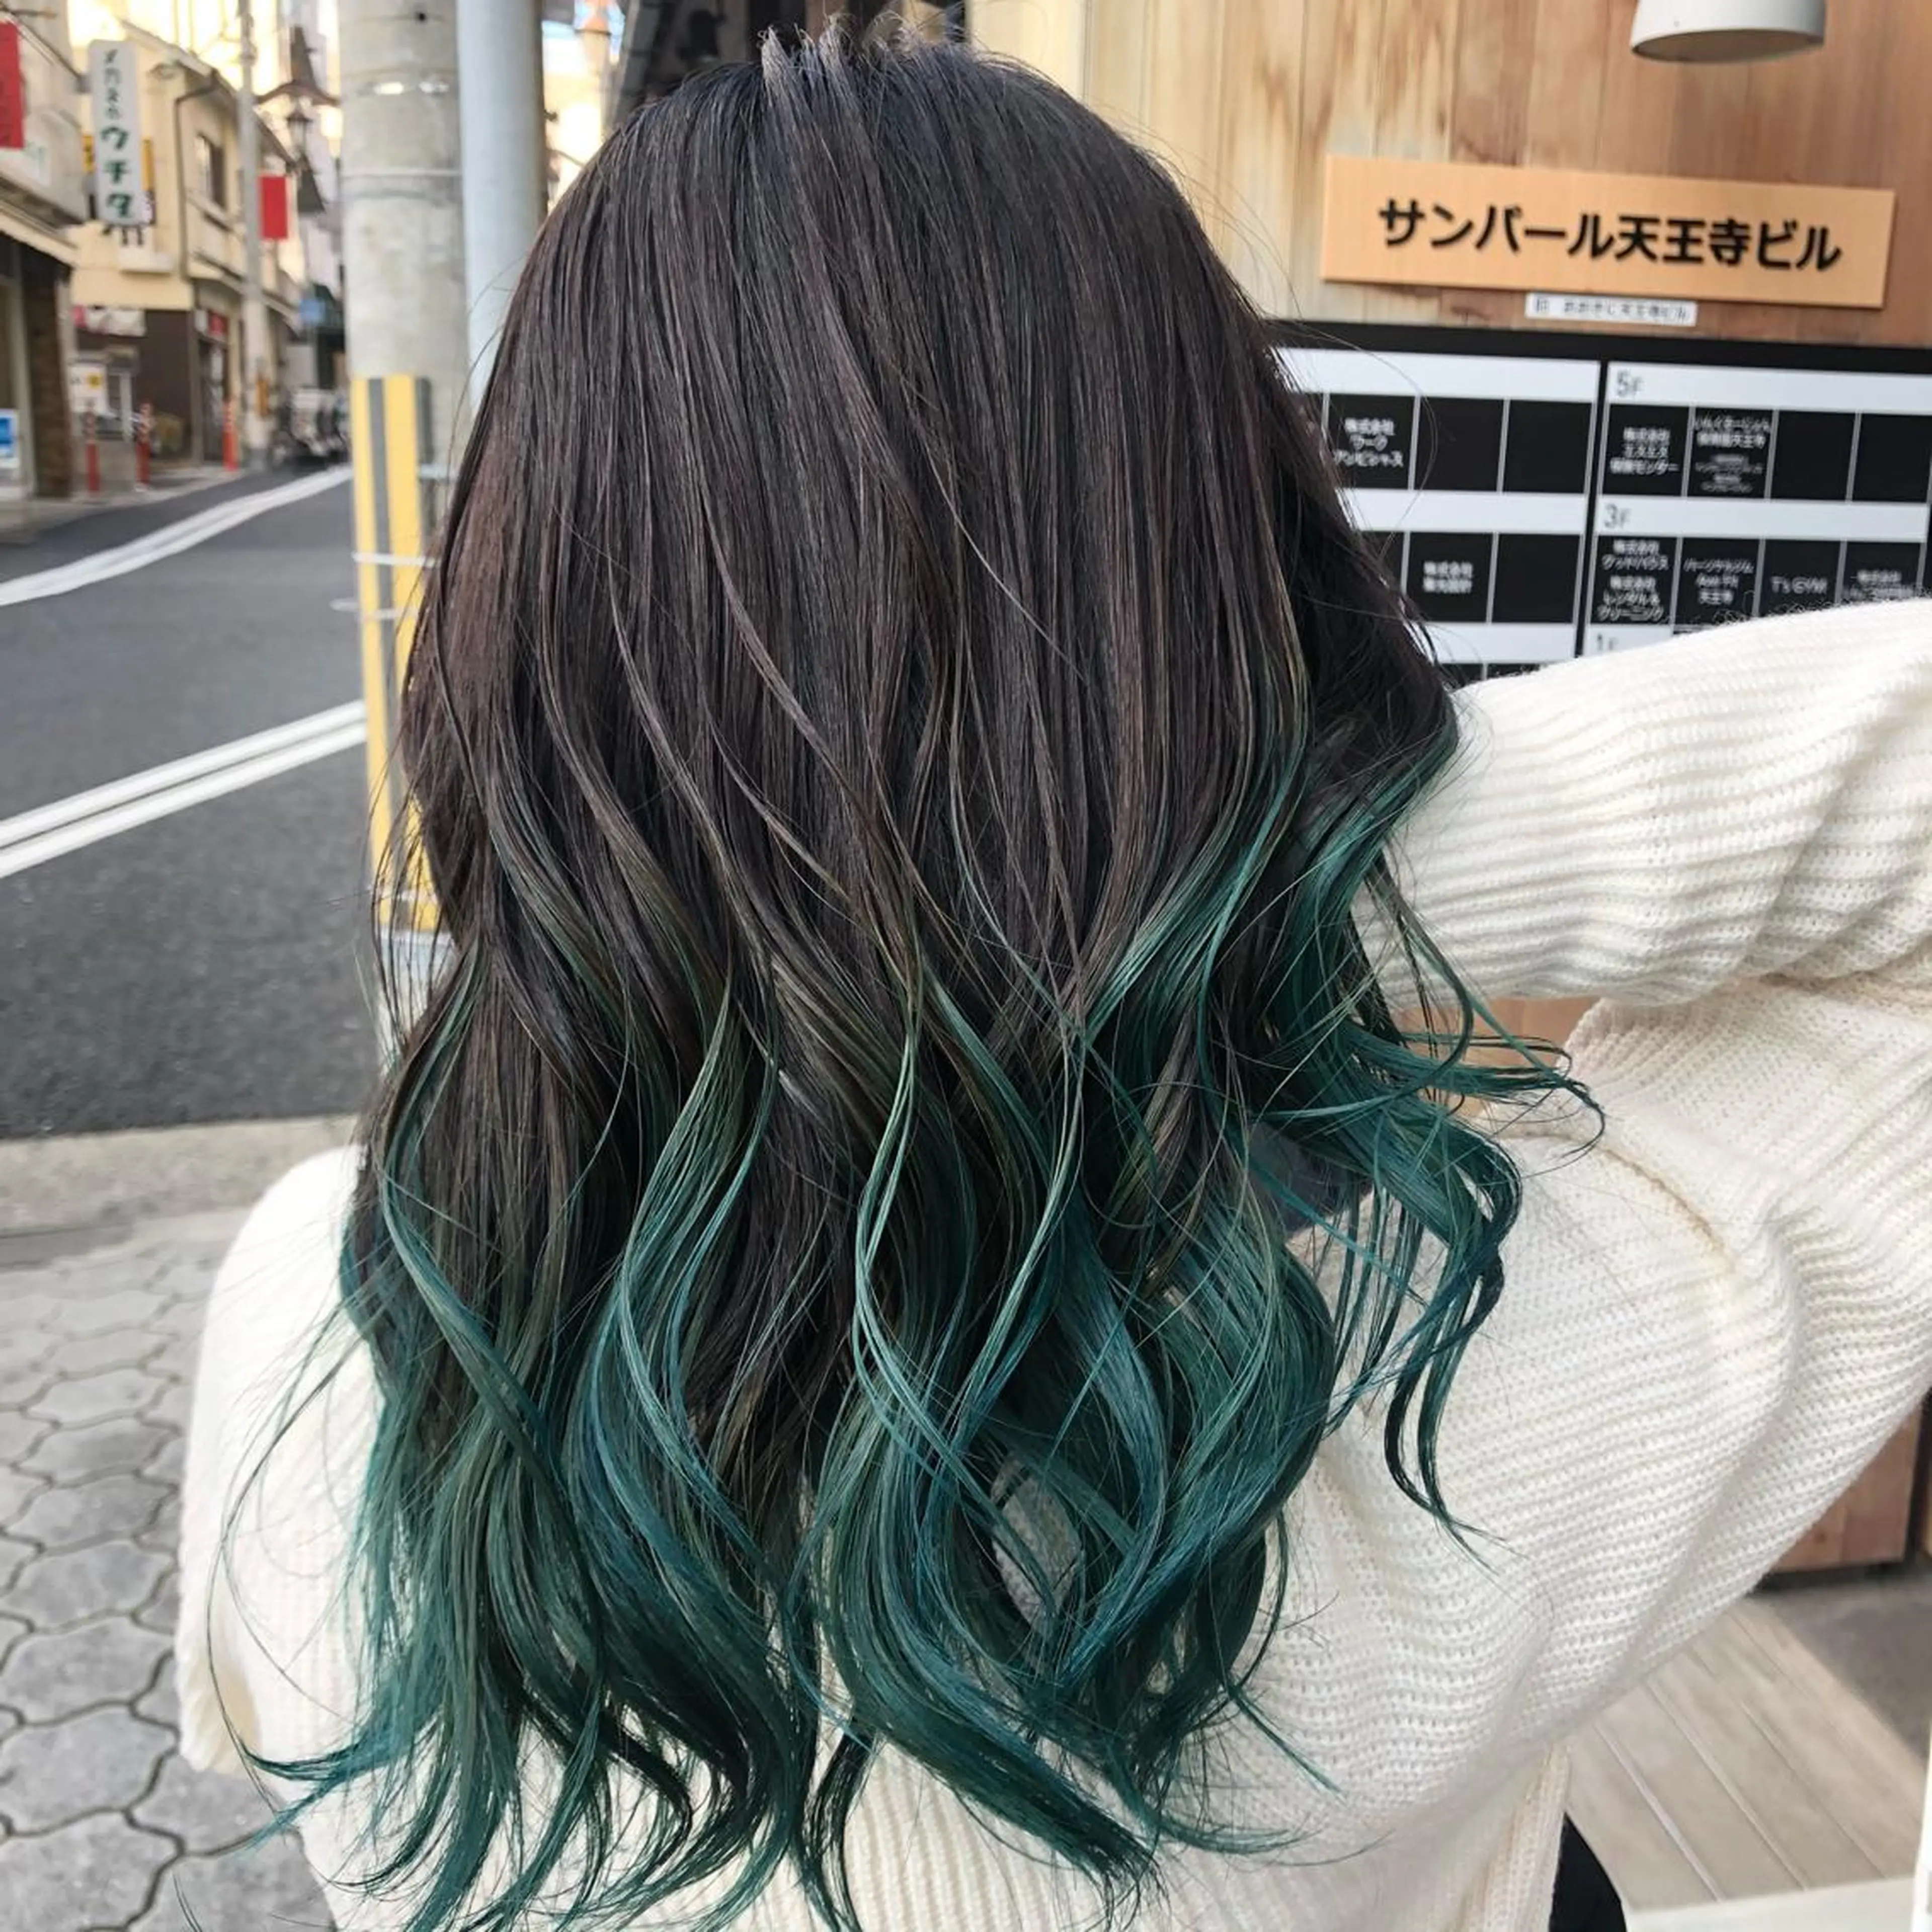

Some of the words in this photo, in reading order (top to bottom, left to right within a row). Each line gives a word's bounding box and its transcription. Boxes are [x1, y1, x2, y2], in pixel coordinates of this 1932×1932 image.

[1379, 198, 1842, 271] サンバール天王寺ビル
[1344, 418, 1395, 435] 株式会社
